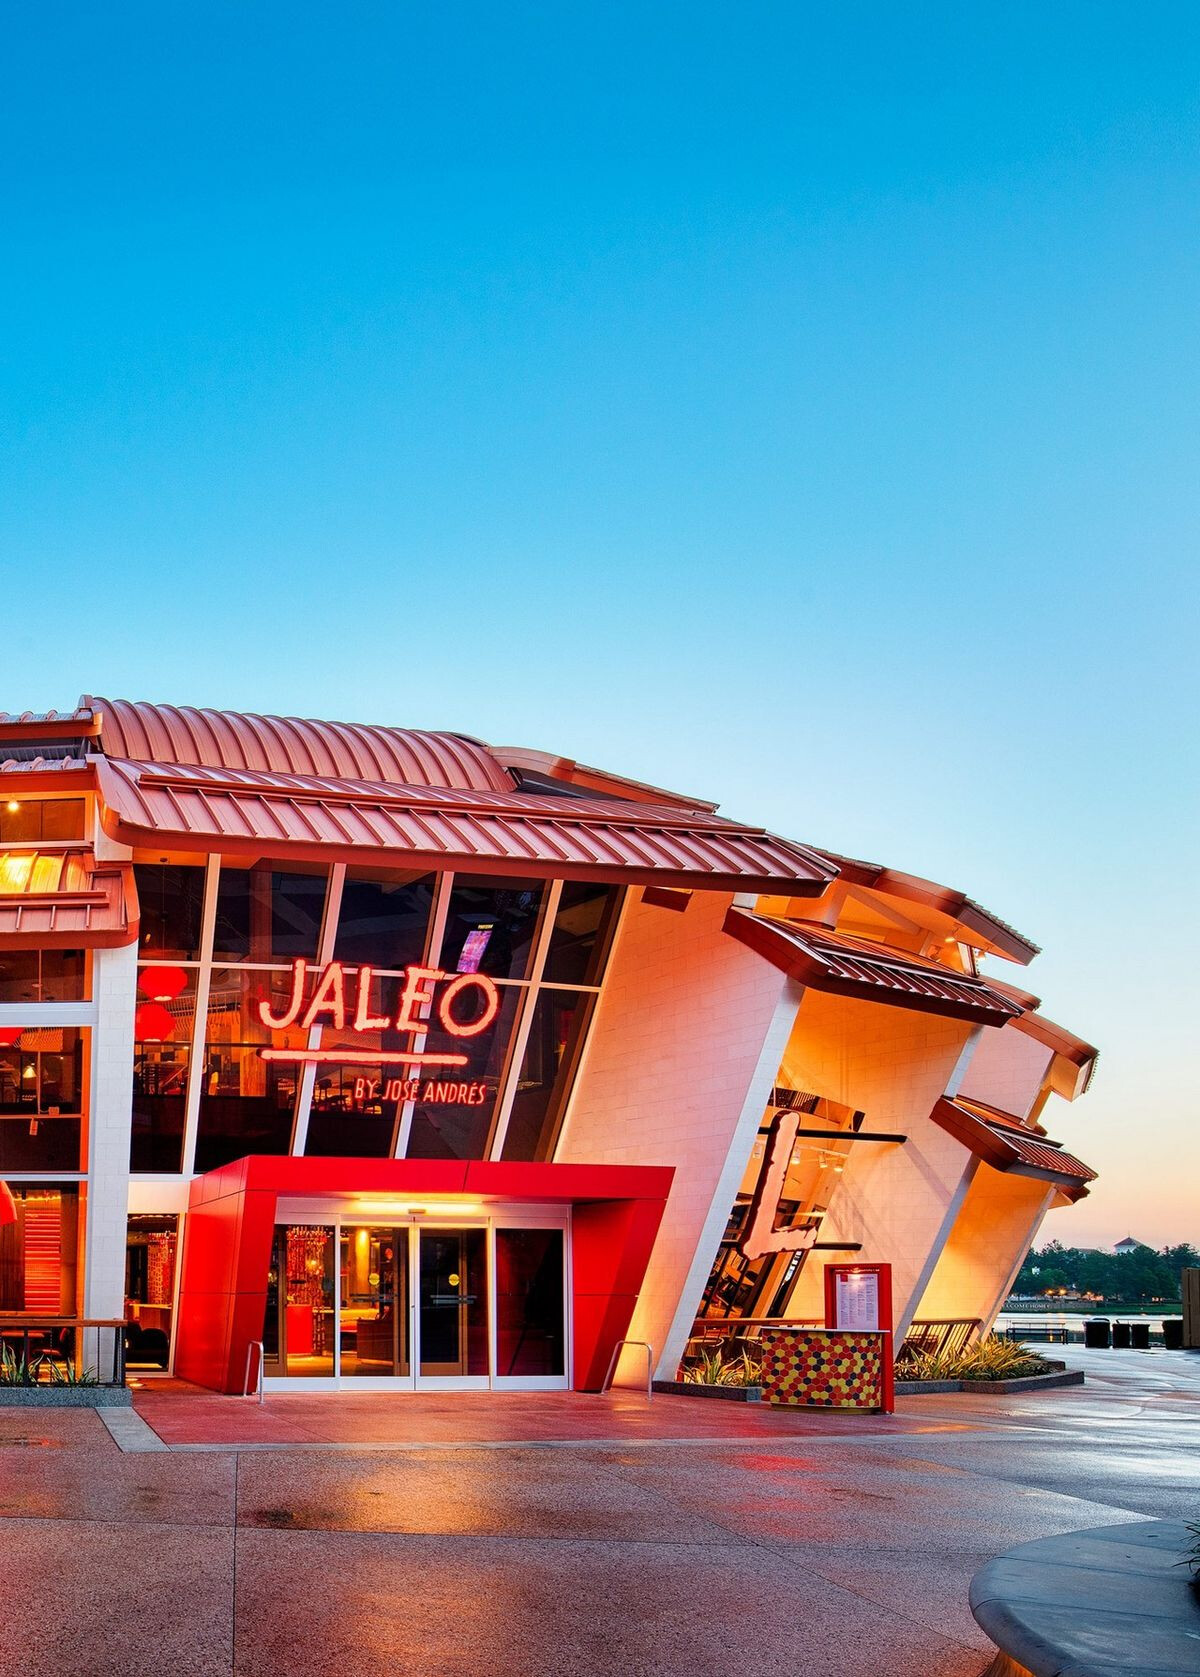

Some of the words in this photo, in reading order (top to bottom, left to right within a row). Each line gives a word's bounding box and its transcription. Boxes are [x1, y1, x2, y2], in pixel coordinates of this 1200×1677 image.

[258, 958, 499, 1037] JALEO
[354, 1078, 378, 1100] BY
[381, 1078, 420, 1102] JOSÉ
[422, 1081, 487, 1105] ANDRÉS
[740, 1110, 819, 1262] L
